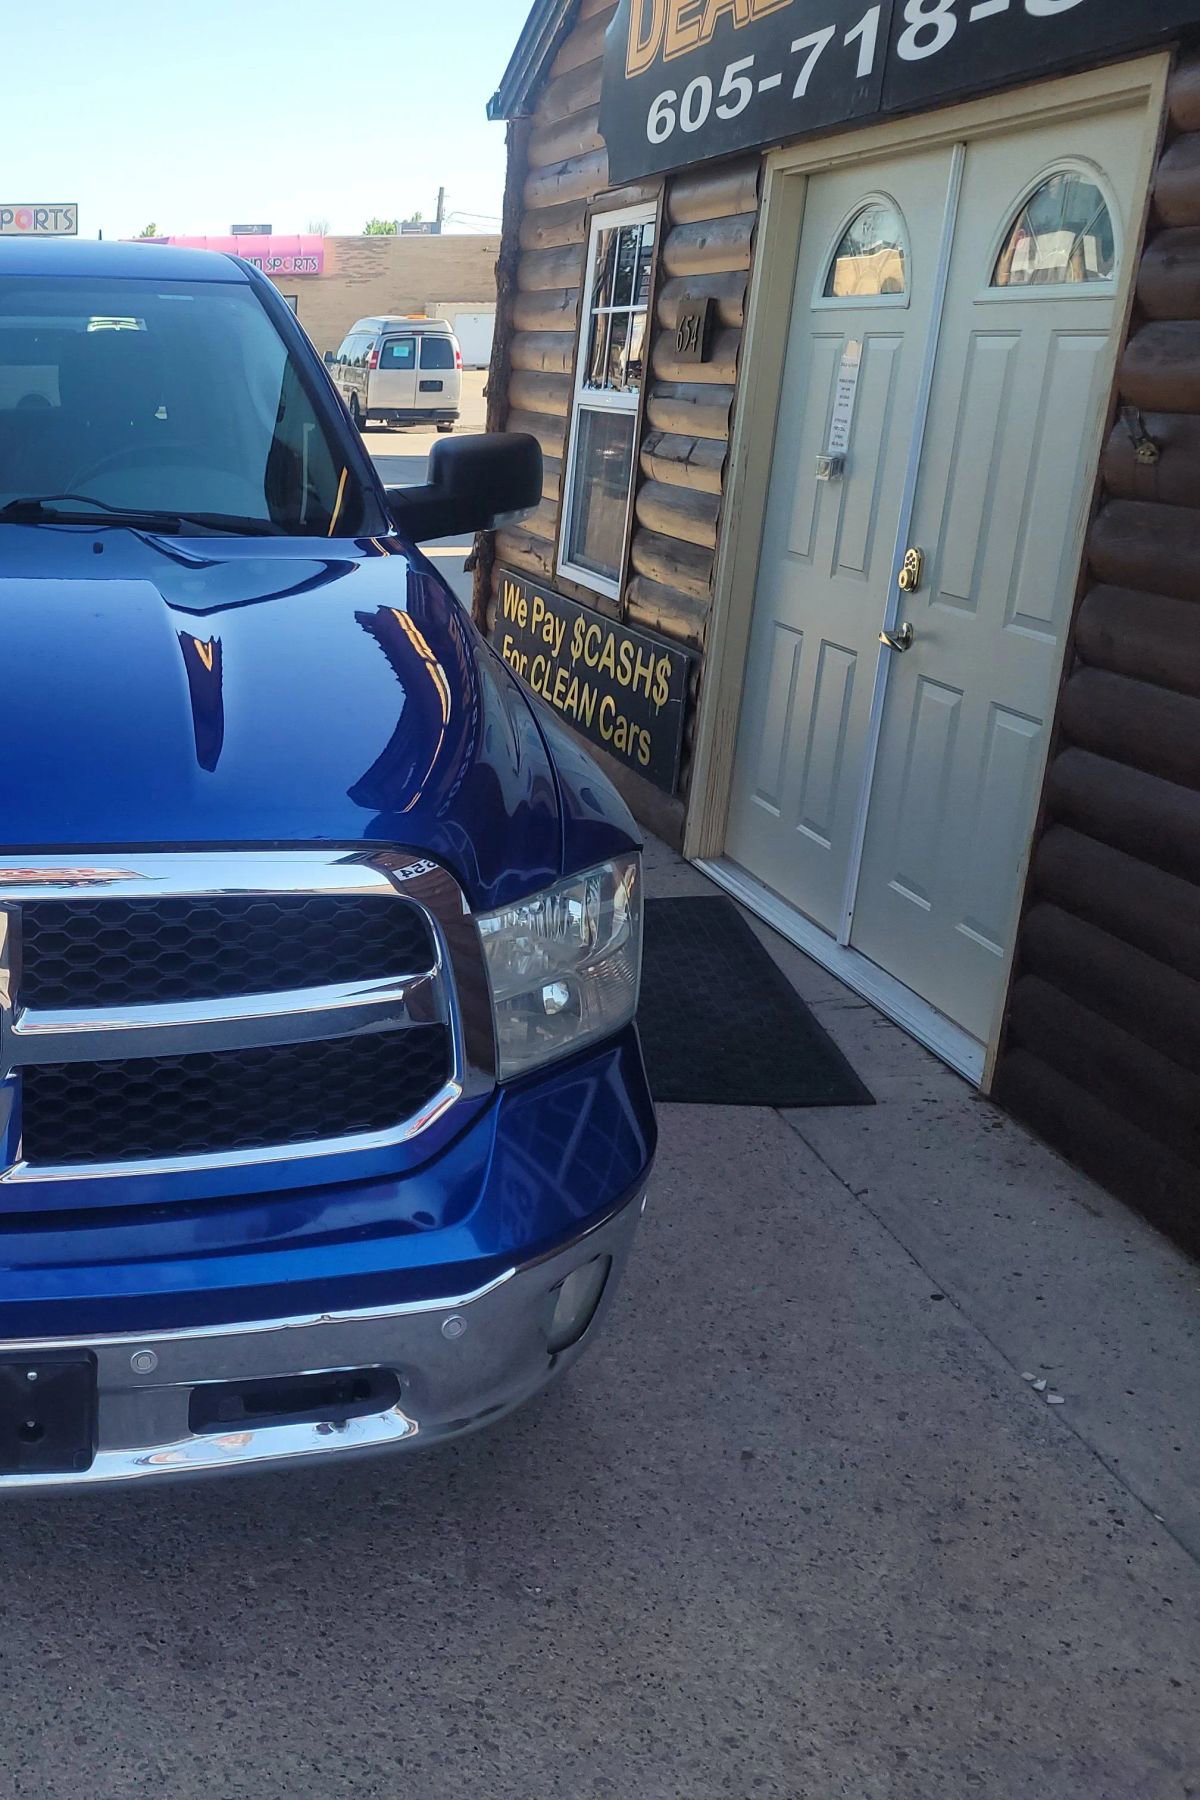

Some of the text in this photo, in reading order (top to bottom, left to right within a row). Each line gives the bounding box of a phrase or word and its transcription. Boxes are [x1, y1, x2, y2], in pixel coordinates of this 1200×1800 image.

[625, 0, 794, 79] DE
[647, 0, 1083, 144] 605-718-
[267, 257, 318, 271] SPORTS
[677, 314, 700, 353] 654
[503, 580, 672, 717] We Pay $CASH$
[530, 654, 598, 728] CLEAN
[599, 695, 652, 766] Cars
